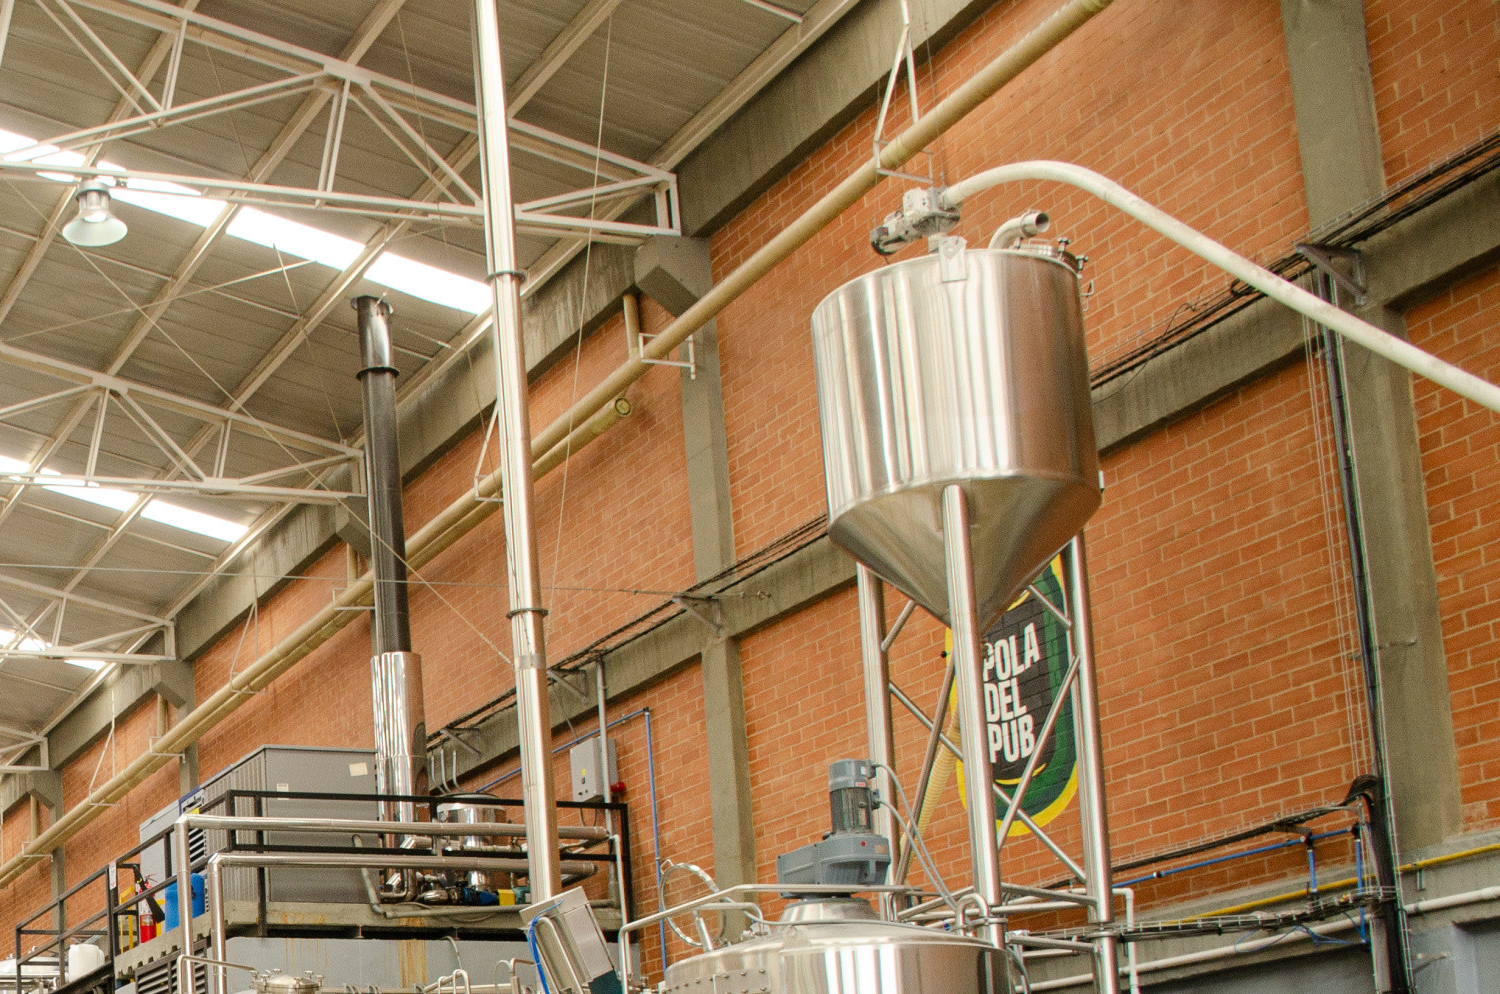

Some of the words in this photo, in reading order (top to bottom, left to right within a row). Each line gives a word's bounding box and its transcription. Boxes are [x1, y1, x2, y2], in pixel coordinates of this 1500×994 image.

[983, 622, 1041, 682] POLA
[984, 677, 1028, 723] DEL
[987, 713, 1037, 763] PUB
